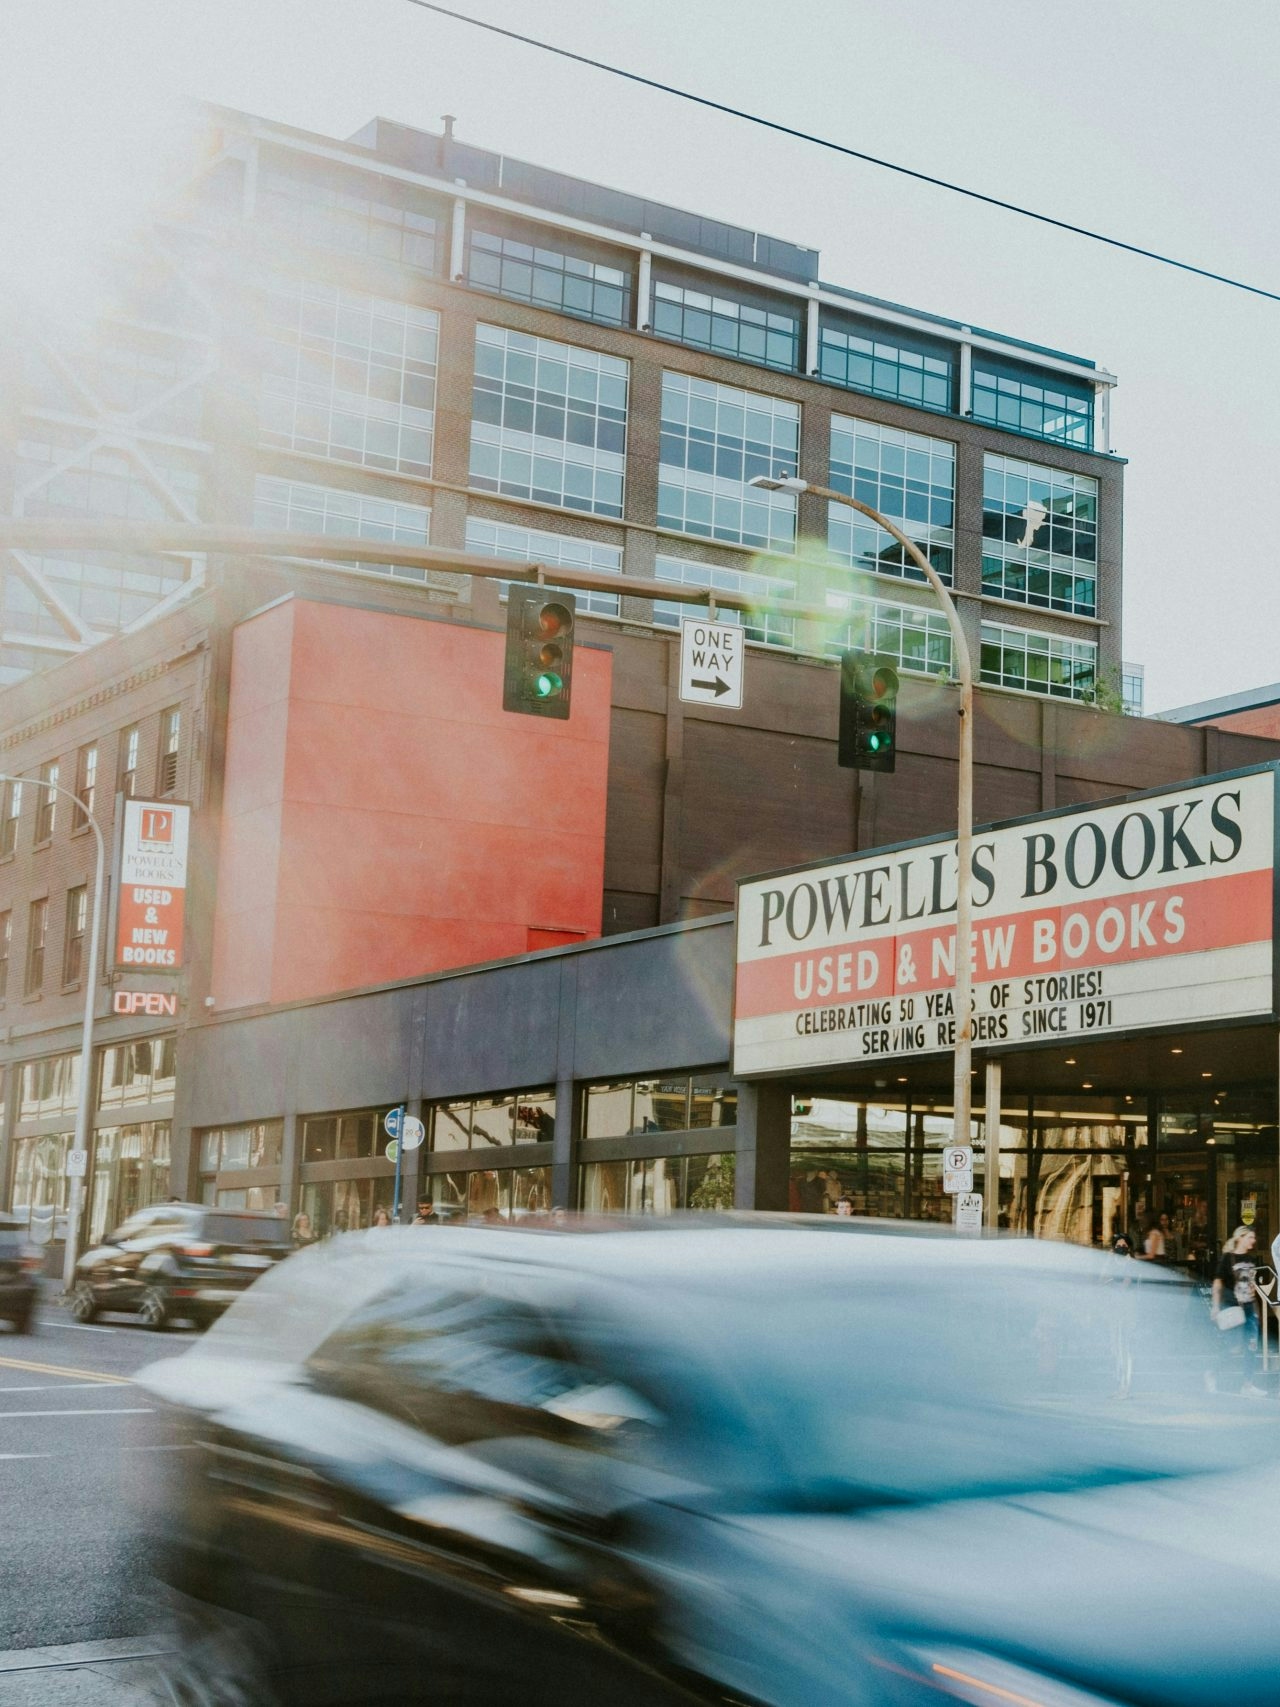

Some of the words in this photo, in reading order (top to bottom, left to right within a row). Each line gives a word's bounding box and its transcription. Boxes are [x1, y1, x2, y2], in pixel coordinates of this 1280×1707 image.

[694, 628, 733, 651] ONE
[692, 649, 734, 672] WAY
[1021, 790, 1243, 898] BOOKS
[127, 853, 183, 869] POWELL'S
[135, 867, 175, 881] BOOKS
[133, 887, 172, 906] USED
[145, 906, 158, 924] &
[132, 927, 167, 945] NEW
[122, 946, 176, 965] BOOKS
[793, 950, 880, 1000] USED
[896, 943, 917, 986] &
[1033, 896, 1186, 964] BOOKS
[113, 990, 177, 1015] OPEN
[796, 1002, 891, 1036] CELEBRATING
[900, 998, 914, 1021] 50
[926, 988, 976, 1018] YEAS
[990, 984, 1010, 1009] OF
[1024, 971, 1103, 1005] STORIES!
[862, 1024, 925, 1055] SERVING
[938, 1013, 1008, 1046] REDERS
[1022, 1007, 1067, 1036] SINCE
[1080, 1000, 1112, 1028] 1971
